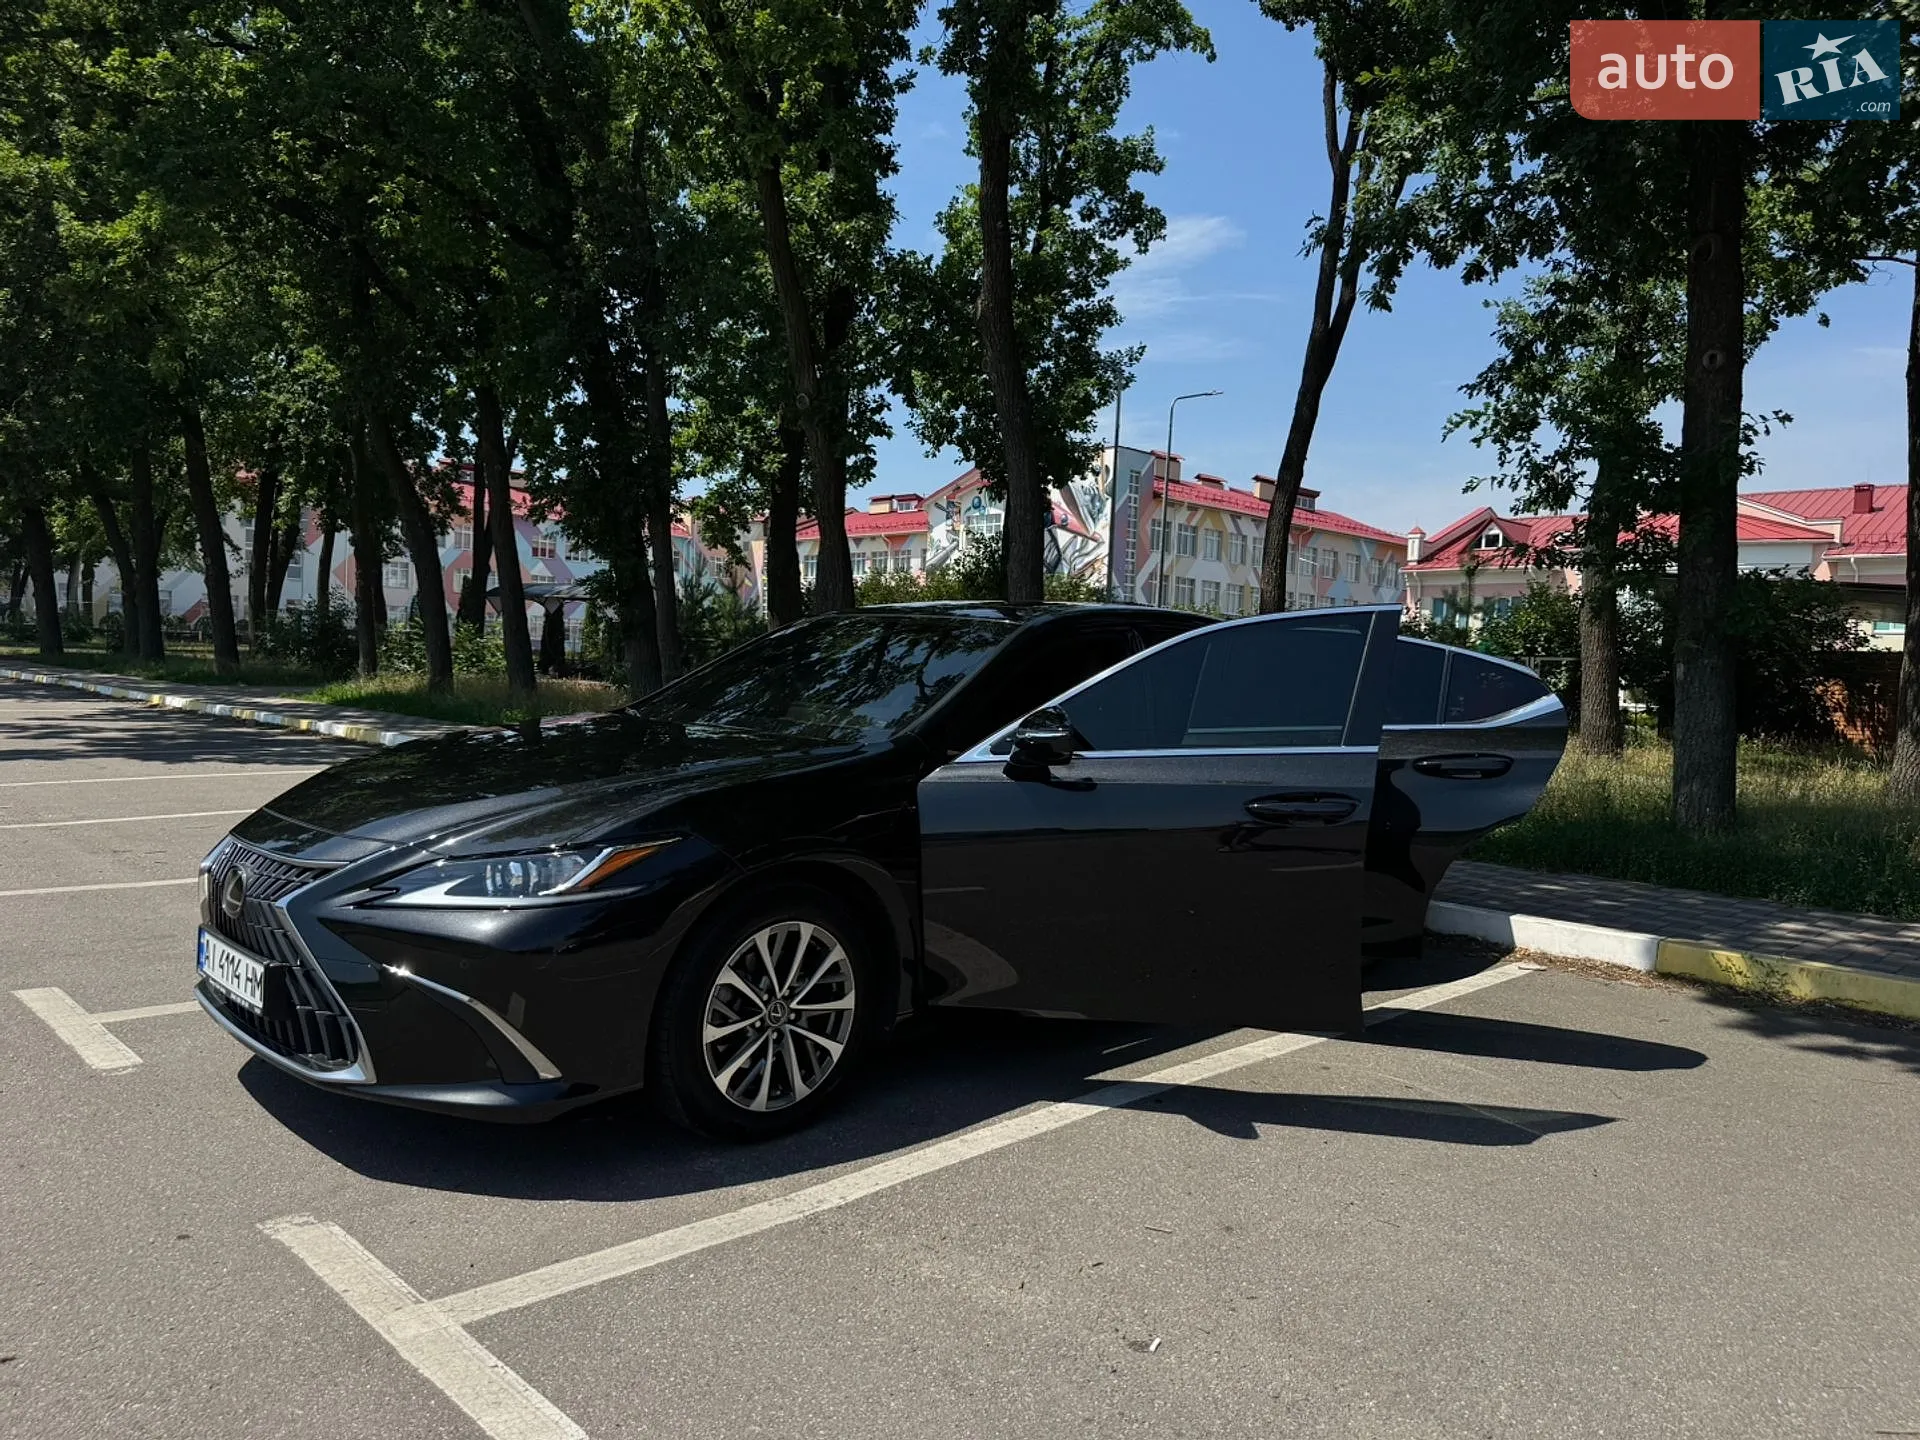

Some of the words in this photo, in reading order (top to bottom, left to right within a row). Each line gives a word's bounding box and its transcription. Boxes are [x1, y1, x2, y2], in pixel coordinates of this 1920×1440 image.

[205, 939, 216, 973] AI
[219, 948, 242, 989] 4114
[243, 961, 263, 1003] HM
